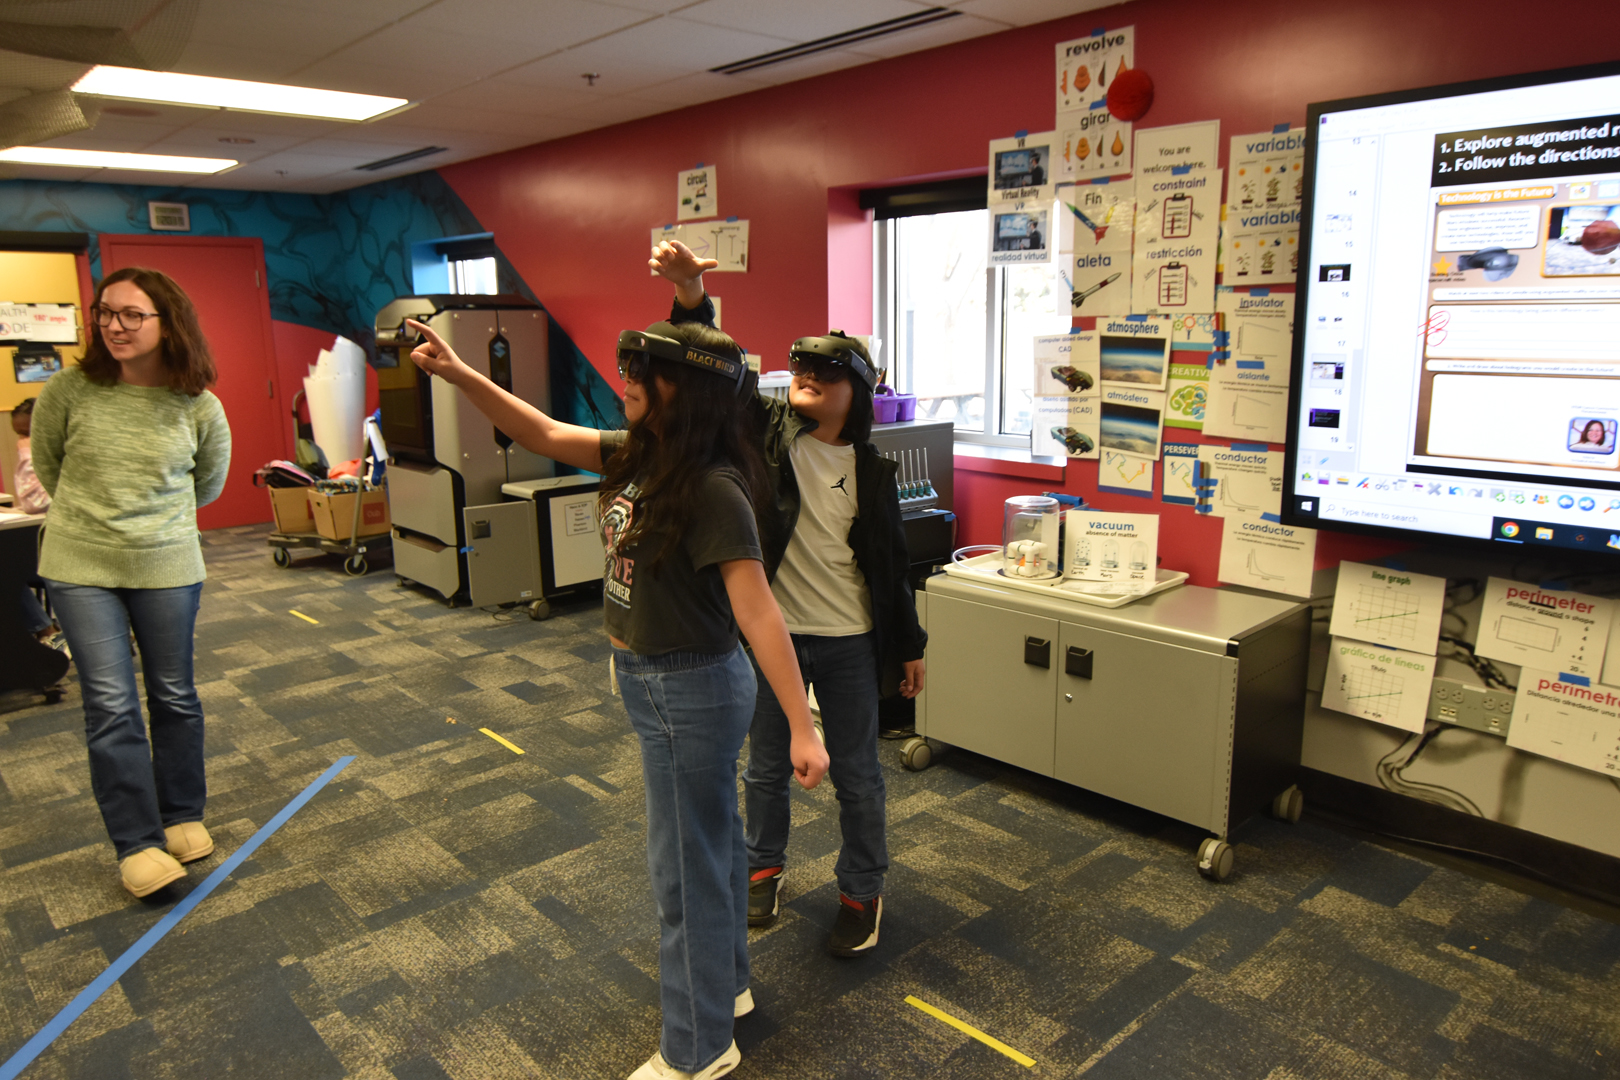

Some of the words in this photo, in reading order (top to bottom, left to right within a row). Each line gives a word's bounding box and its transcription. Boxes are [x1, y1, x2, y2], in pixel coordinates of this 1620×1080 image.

[1066, 34, 1125, 57] revolve
[1080, 112, 1111, 130] girar
[1018, 138, 1025, 148] VR
[1440, 142, 1451, 154] 1.
[1454, 135, 1513, 154] Explore
[1515, 122, 1611, 148] augmented
[1159, 147, 1175, 156] You
[1177, 146, 1191, 154] are
[1438, 161, 1452, 173] 2.
[1454, 155, 1506, 171] Follow
[1509, 151, 1536, 166] the
[1538, 145, 1620, 164] directions
[687, 171, 708, 186] circuit
[1153, 177, 1206, 192] constraint
[1001, 189, 1019, 200] Virtual
[1021, 187, 1039, 198] Reality
[1085, 193, 1102, 205] Fin
[1441, 192, 1493, 202] Technology
[1503, 189, 1519, 198] the
[1521, 186, 1553, 197] Future
[1241, 209, 1301, 227] variable
[991, 252, 1022, 262] realidad
[1024, 251, 1047, 260] virtual
[1146, 245, 1203, 260] restricción
[1077, 253, 1111, 268] aleta
[1240, 297, 1285, 308] insulator
[1107, 321, 1159, 337] atmosphere
[1237, 372, 1270, 381] aislante
[1107, 391, 1149, 404] atmósfera
[1214, 453, 1268, 464] conductor
[1342, 507, 1359, 516] Type
[1361, 510, 1379, 518] here
[1391, 514, 1418, 523] search
[1089, 521, 1134, 531] vacuum
[1242, 522, 1295, 537] conductor
[1371, 570, 1386, 580] line
[1388, 575, 1411, 586] graph
[1506, 586, 1596, 614] perimeter
[1506, 600, 1536, 611] distance
[1571, 615, 1595, 625] shape
[1340, 646, 1376, 660] gráfico
[1378, 654, 1392, 663] de
[1394, 656, 1425, 671] líneas
[1527, 689, 1560, 703] Distancia
[1562, 699, 1599, 713] alrededor
